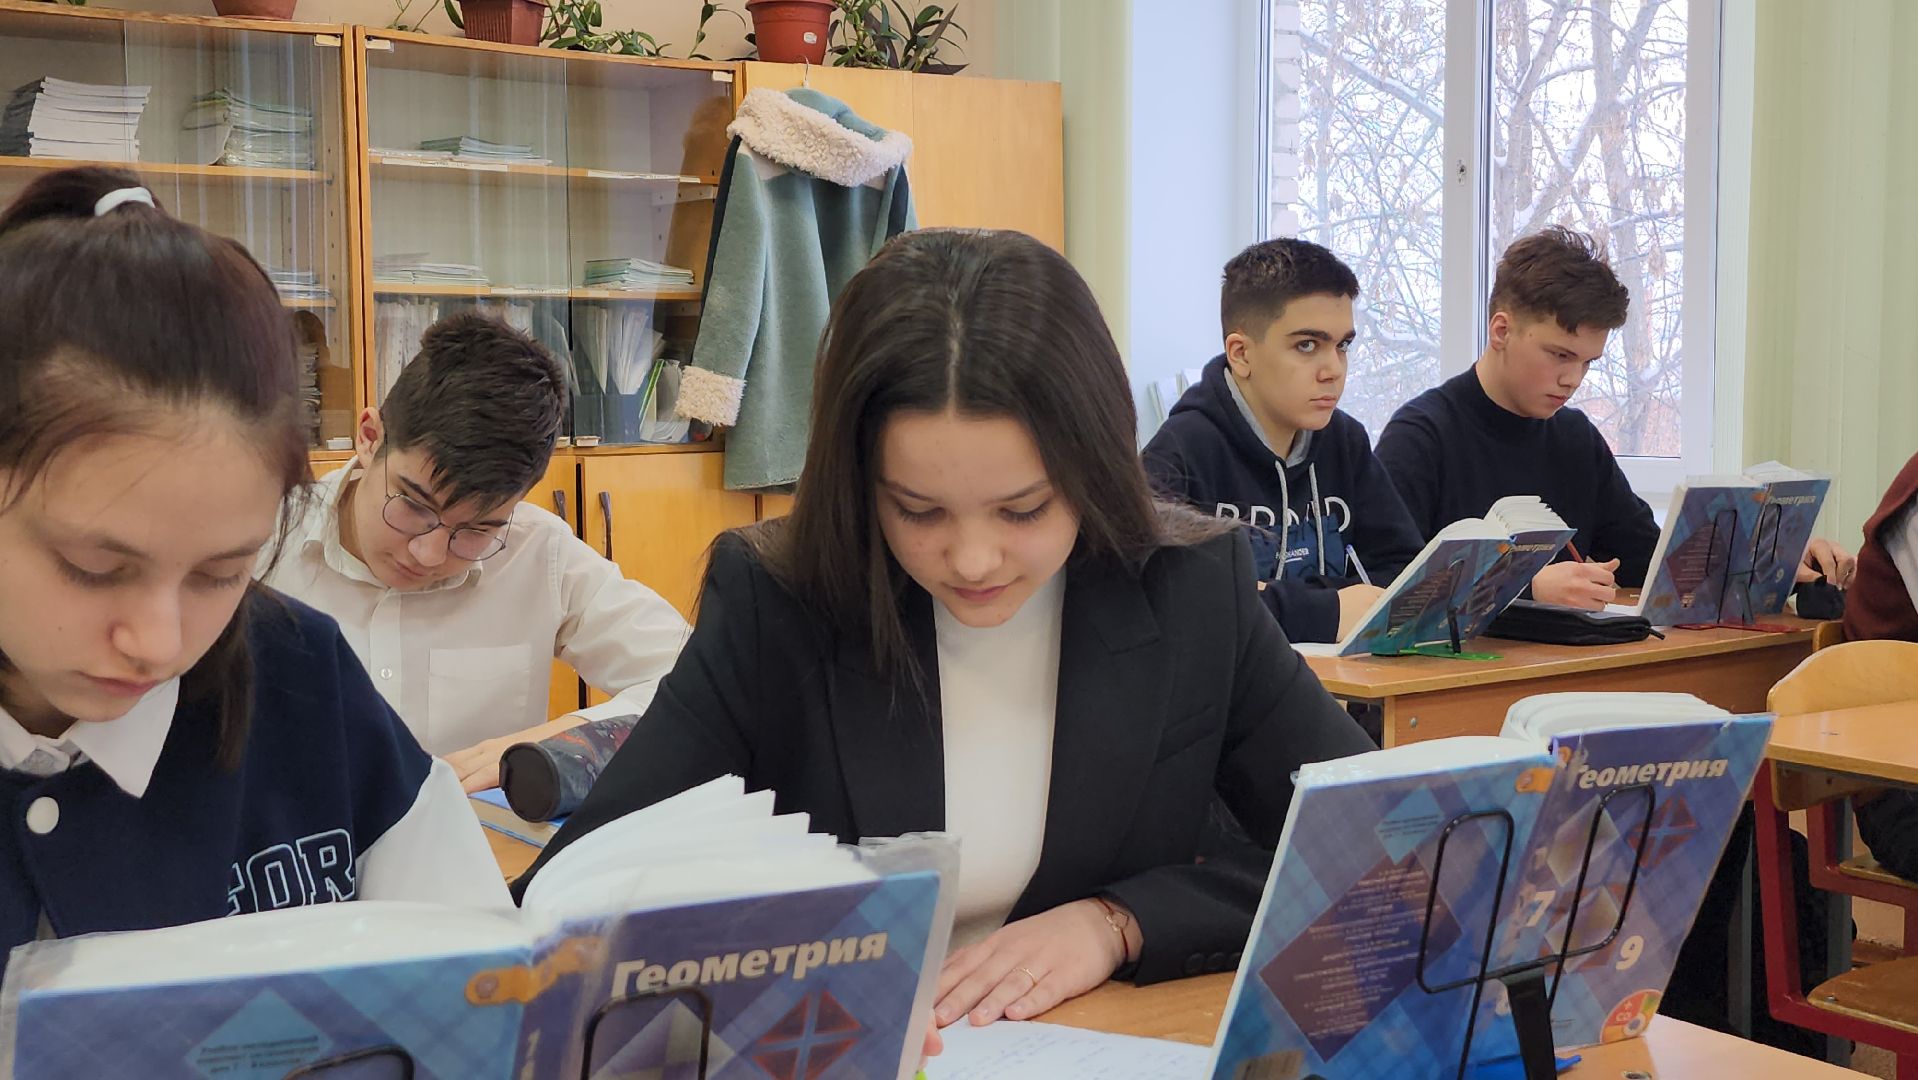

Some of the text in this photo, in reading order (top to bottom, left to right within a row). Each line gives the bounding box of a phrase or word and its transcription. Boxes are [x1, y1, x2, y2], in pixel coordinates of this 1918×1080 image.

[227, 828, 355, 917] OR
[610, 931, 889, 998] Геометрия
[1615, 935, 1645, 971] 9
